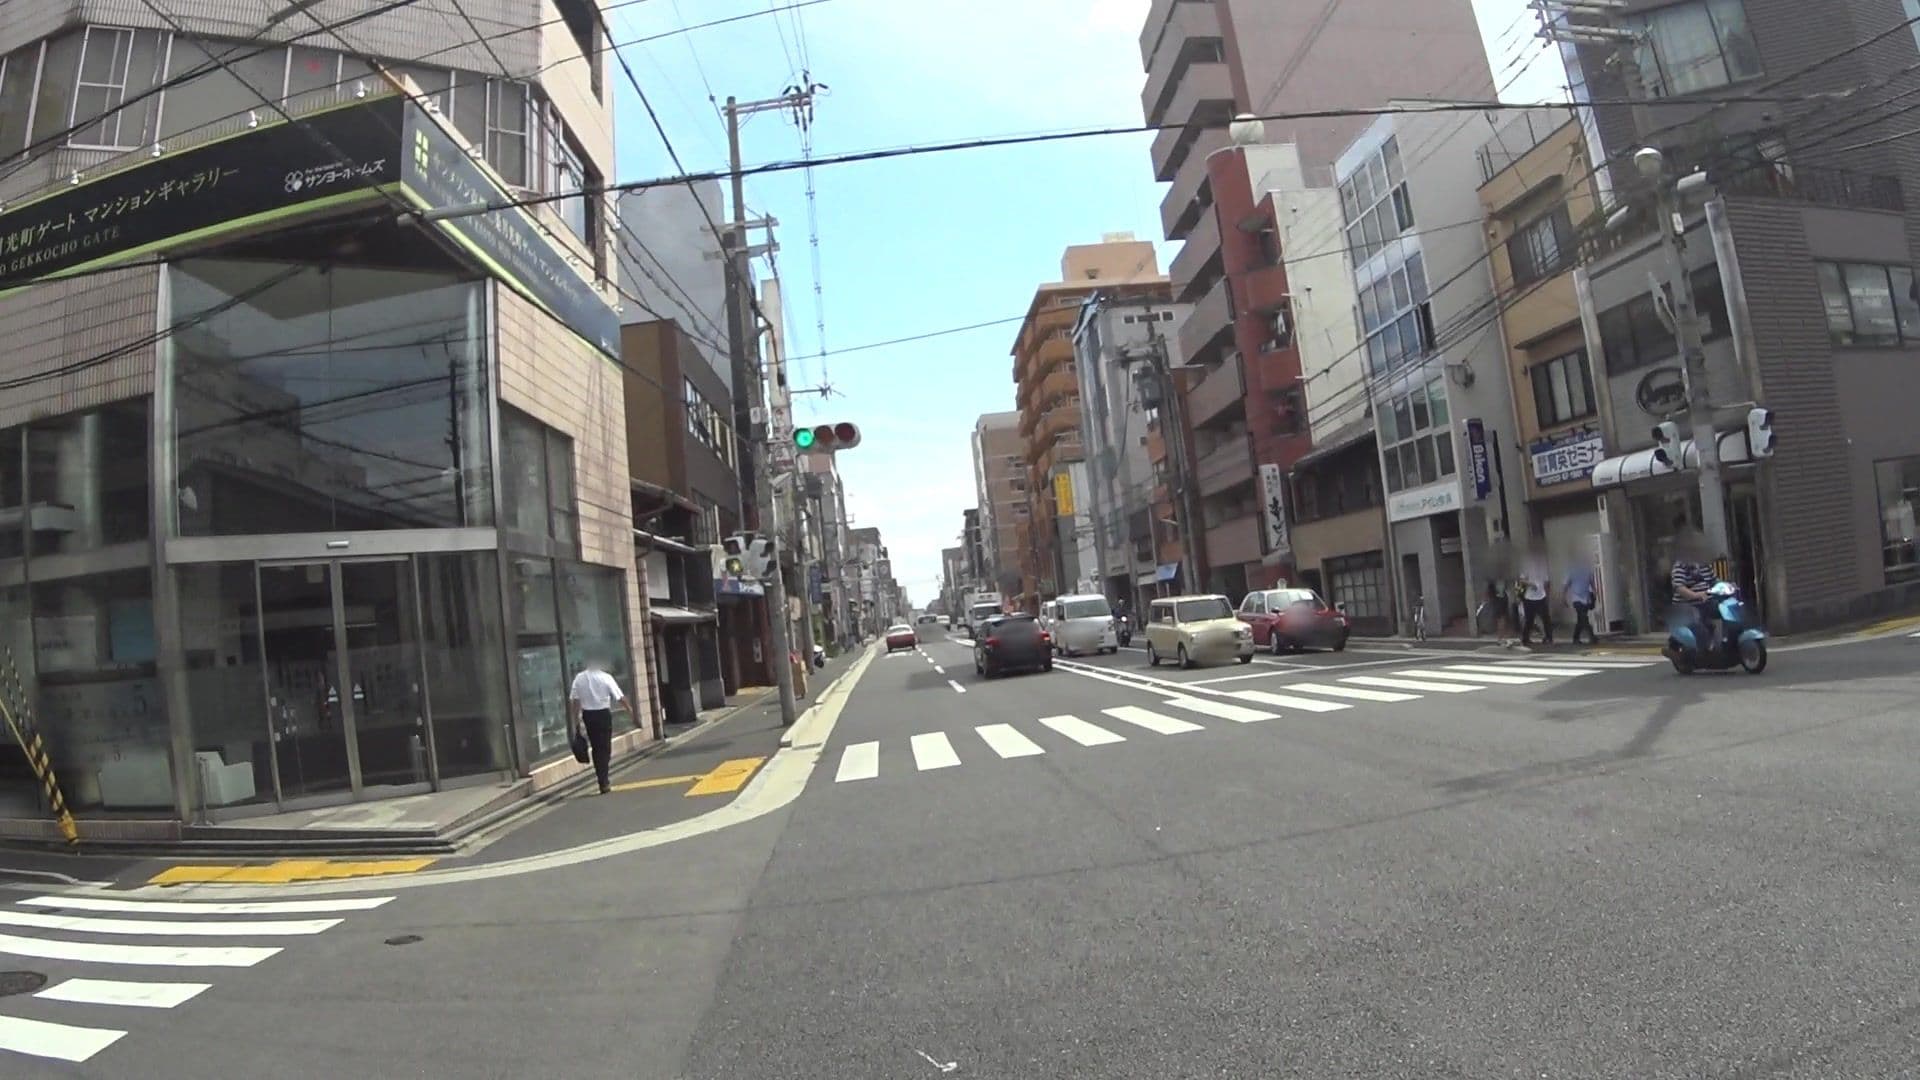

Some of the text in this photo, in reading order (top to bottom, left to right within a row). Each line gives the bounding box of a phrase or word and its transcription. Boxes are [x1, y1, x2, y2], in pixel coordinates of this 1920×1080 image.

[84, 166, 242, 223] マンションギャラリー
[305, 159, 386, 188] サンヨーホームズ
[11, 240, 78, 271] GEKKOCHO
[83, 225, 120, 247] GATE
